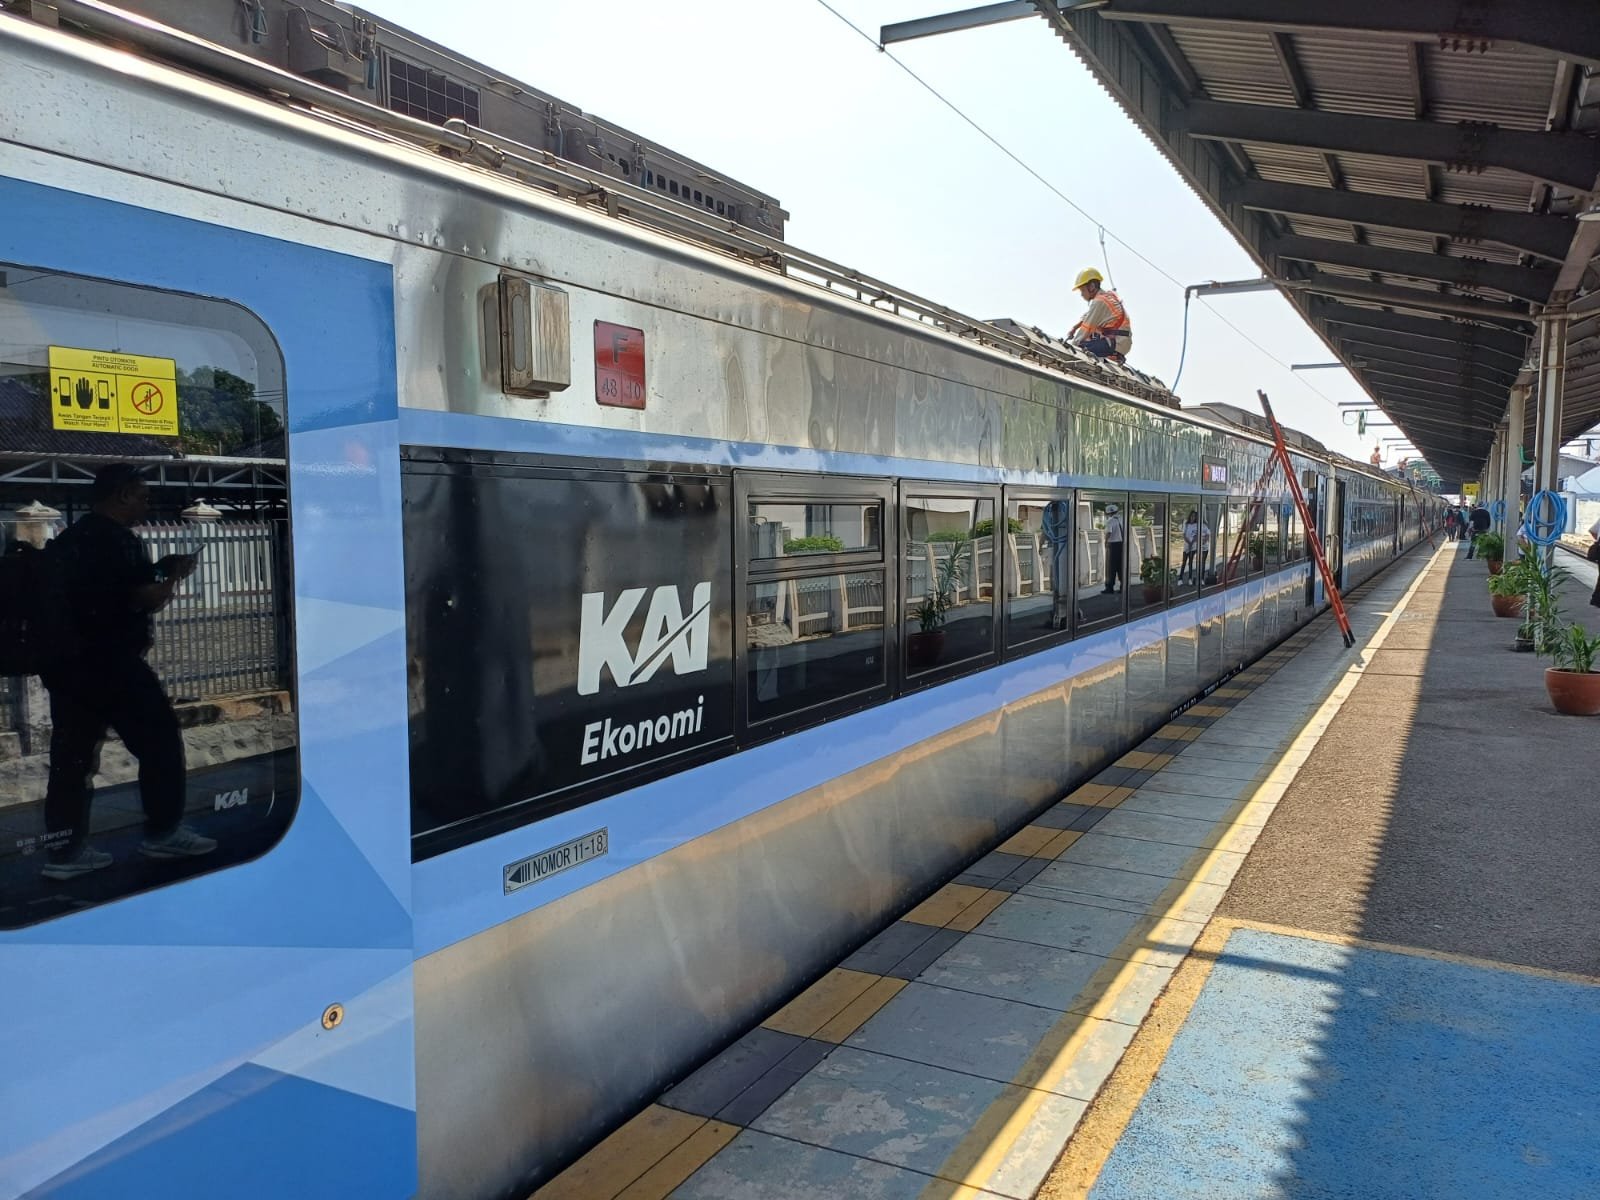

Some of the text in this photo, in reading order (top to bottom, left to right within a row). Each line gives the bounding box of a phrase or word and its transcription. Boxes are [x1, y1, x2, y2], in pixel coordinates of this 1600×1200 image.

[612, 332, 629, 363] F
[602, 377, 618, 397] 48
[577, 581, 712, 696] KAI
[580, 695, 704, 766] Ekonomi
[214, 787, 249, 811] KAI
[533, 835, 603, 878] NOMOR 11-18
